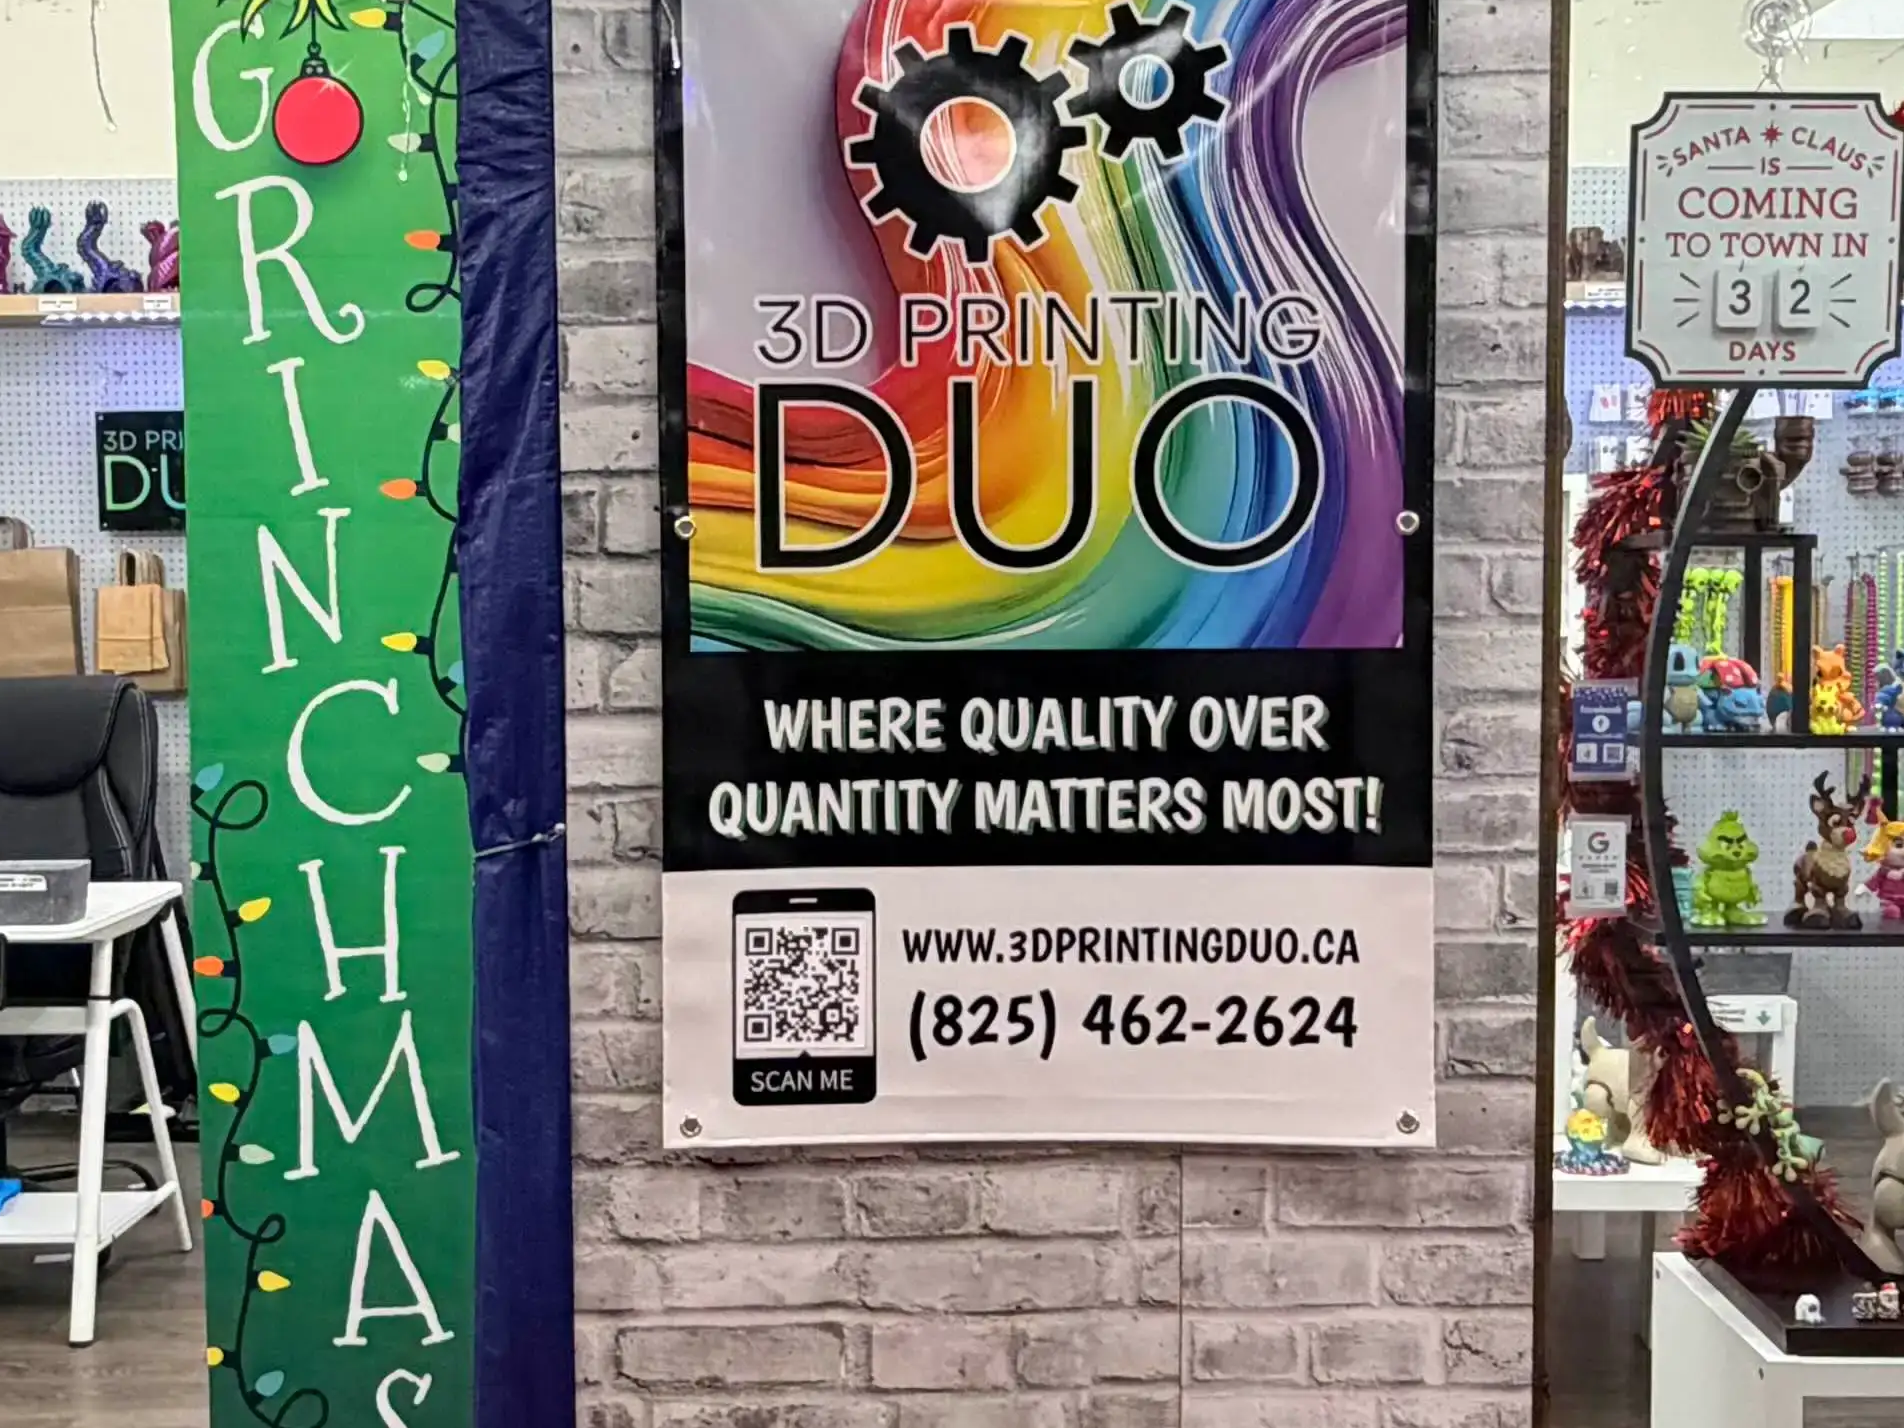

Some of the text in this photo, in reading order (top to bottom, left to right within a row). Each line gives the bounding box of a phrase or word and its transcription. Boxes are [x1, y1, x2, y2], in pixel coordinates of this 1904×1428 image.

[1672, 125, 1869, 172] SANTA CLAUS
[1760, 157, 1781, 176] IS
[1677, 186, 1859, 220] COMING
[1665, 231, 1869, 258] TO TOWN IN
[759, 294, 1323, 366] 3D PRINTING
[1729, 340, 1797, 362] DAYS
[103, 430, 137, 452] 3D
[757, 378, 1324, 572] DUO
[764, 694, 1328, 756] WHERE QUALITY OVER
[708, 776, 1384, 839] QUANTITY MATTERS MOST!
[903, 926, 1360, 965] WWW.3DPRINTINGDUO.CA
[908, 989, 1358, 1062] (825) 462-2624
[750, 1068, 854, 1095] SCAN ME
